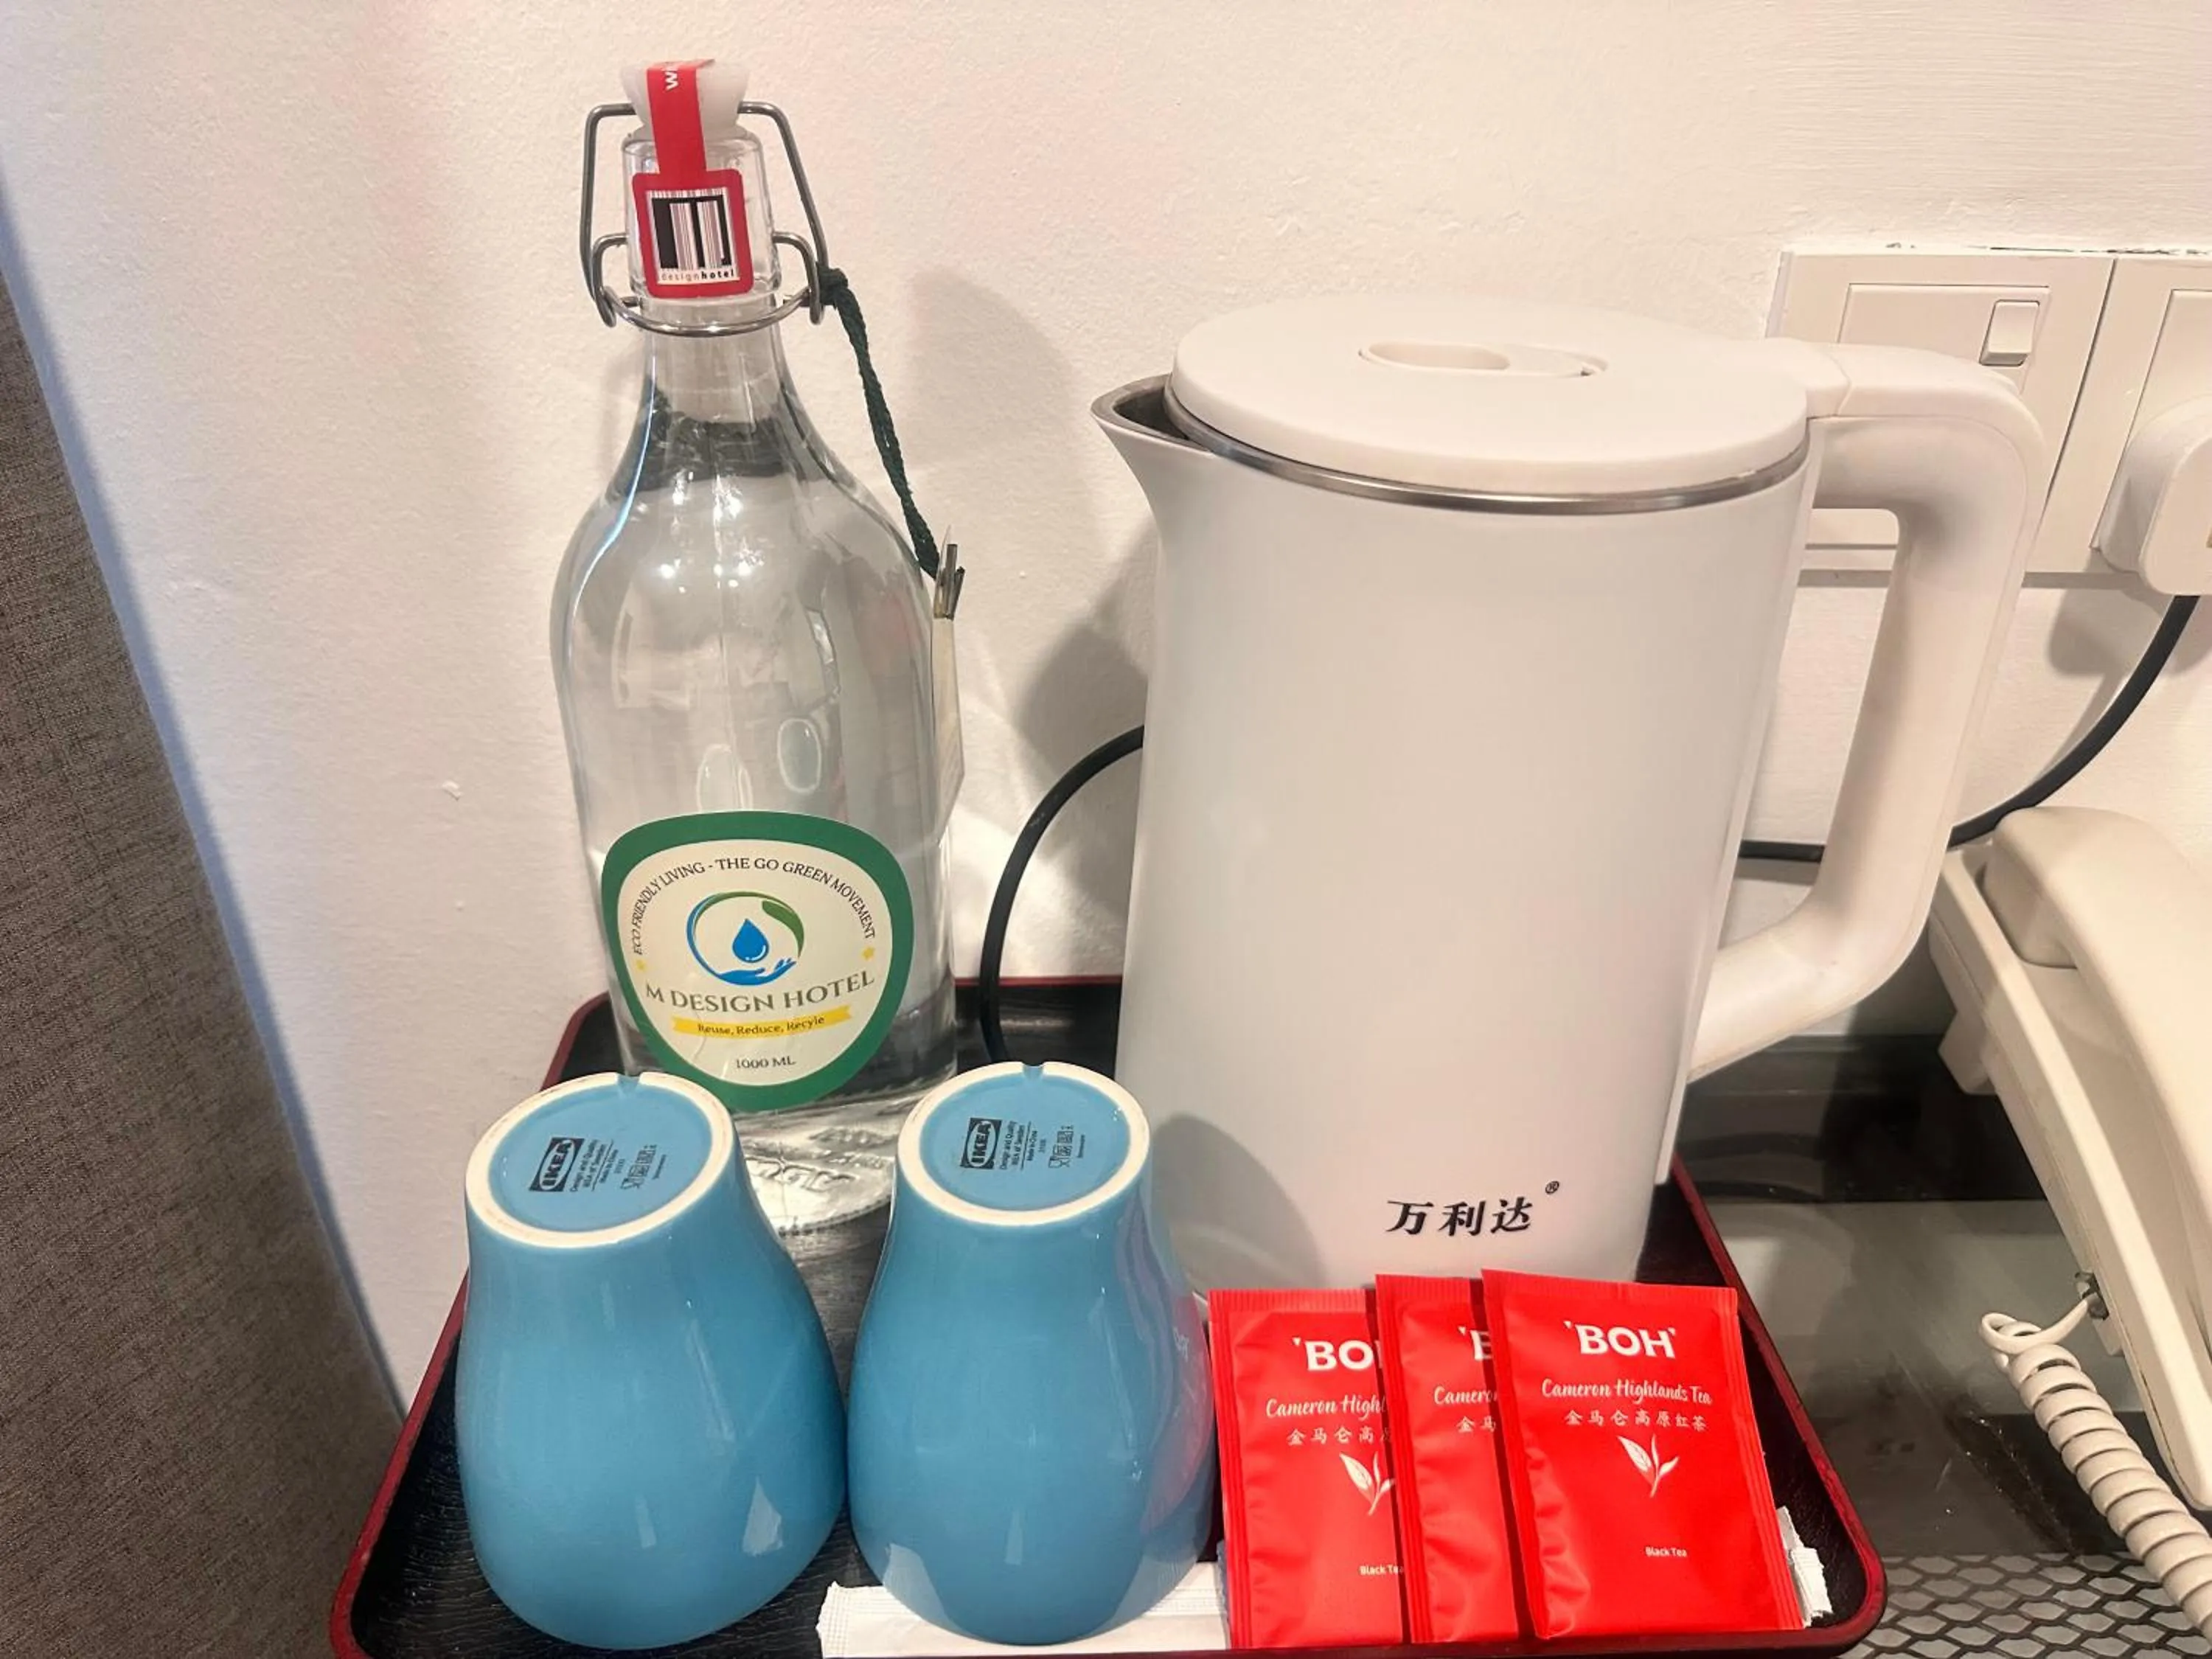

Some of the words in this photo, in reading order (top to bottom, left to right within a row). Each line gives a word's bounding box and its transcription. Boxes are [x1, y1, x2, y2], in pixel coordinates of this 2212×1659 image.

[658, 862, 706, 886] LIVING
[715, 858, 751, 870] THE
[754, 858, 779, 871] GO
[782, 861, 833, 886] GREEN
[631, 879, 662, 929] FRIENDLY
[830, 878, 876, 939] MOVEMENT
[631, 928, 643, 956] ECO
[646, 982, 665, 1003] M
[671, 990, 774, 1013] DESIGN
[784, 970, 875, 1009] HOTEL
[737, 1057, 770, 1069] 1000
[772, 1055, 797, 1068] ML
[1385, 1197, 1533, 1237] 万利达
[1542, 1378, 1611, 1398] Cameron
[1615, 1378, 1688, 1405] Highlands
[1690, 1385, 1713, 1405] Tea
[1266, 1397, 1338, 1419] Cameron
[1565, 1409, 1707, 1433] 金马仑高原红茶
[1645, 1545, 1669, 1557] Black
[1360, 1564, 1385, 1576] Black
